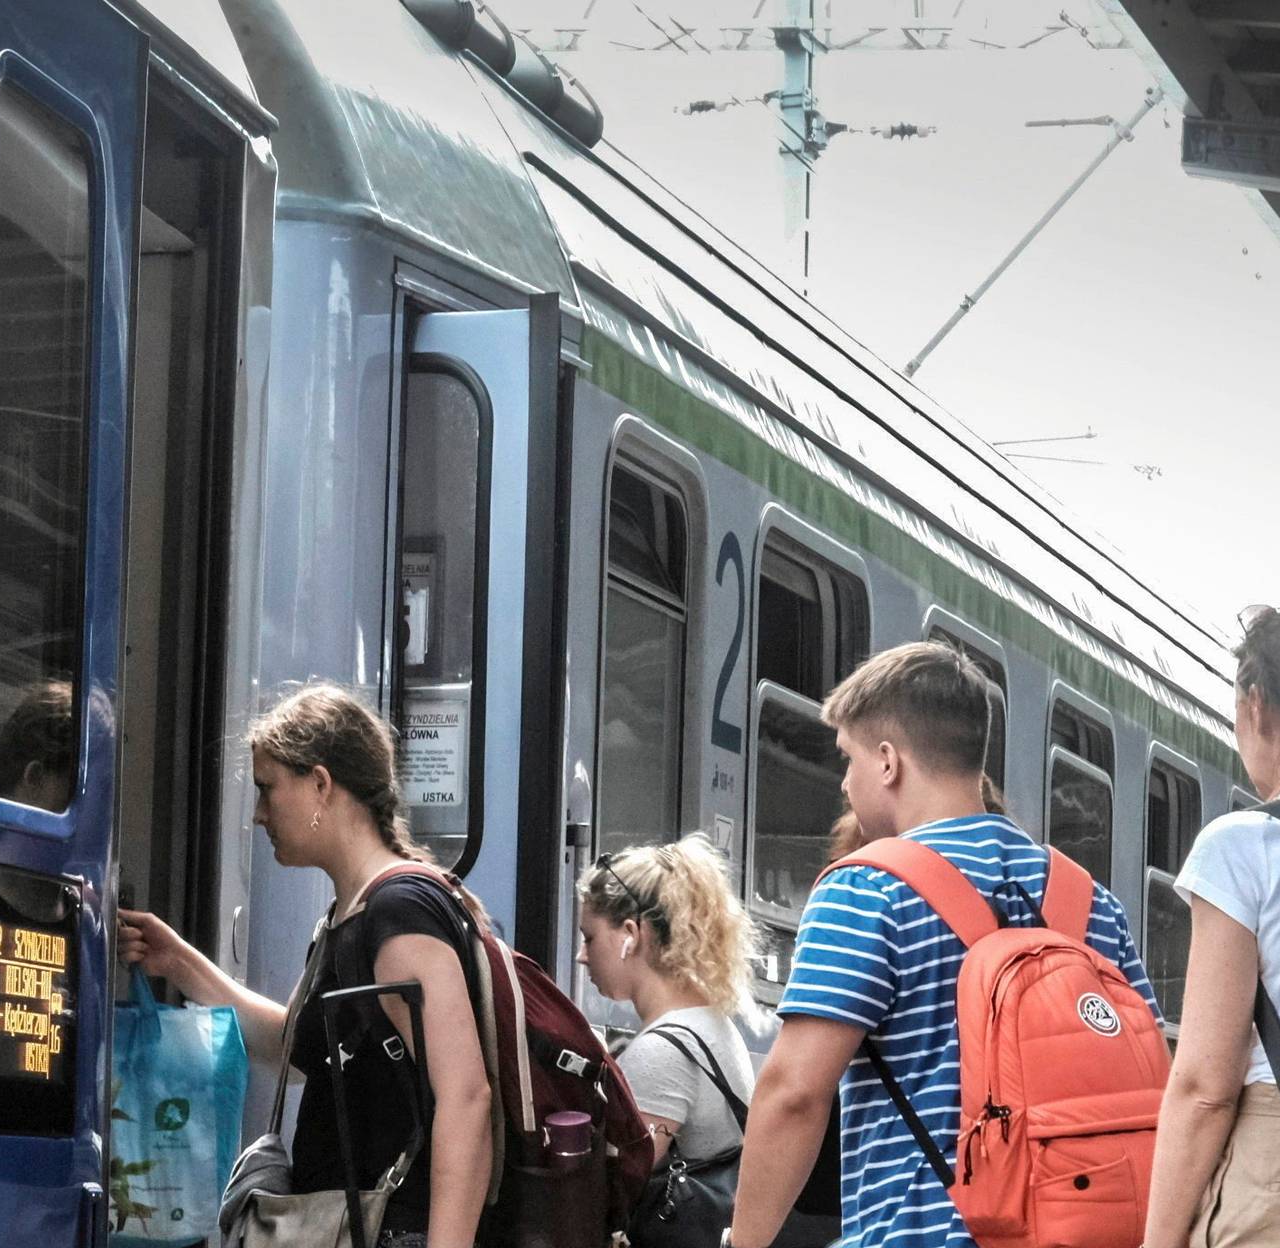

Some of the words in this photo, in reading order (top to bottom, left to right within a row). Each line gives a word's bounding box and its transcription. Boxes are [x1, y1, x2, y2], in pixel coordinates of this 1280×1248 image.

[711, 531, 745, 754] 2
[423, 792, 455, 803] USTKA
[50, 1024, 61, 1054] 16
